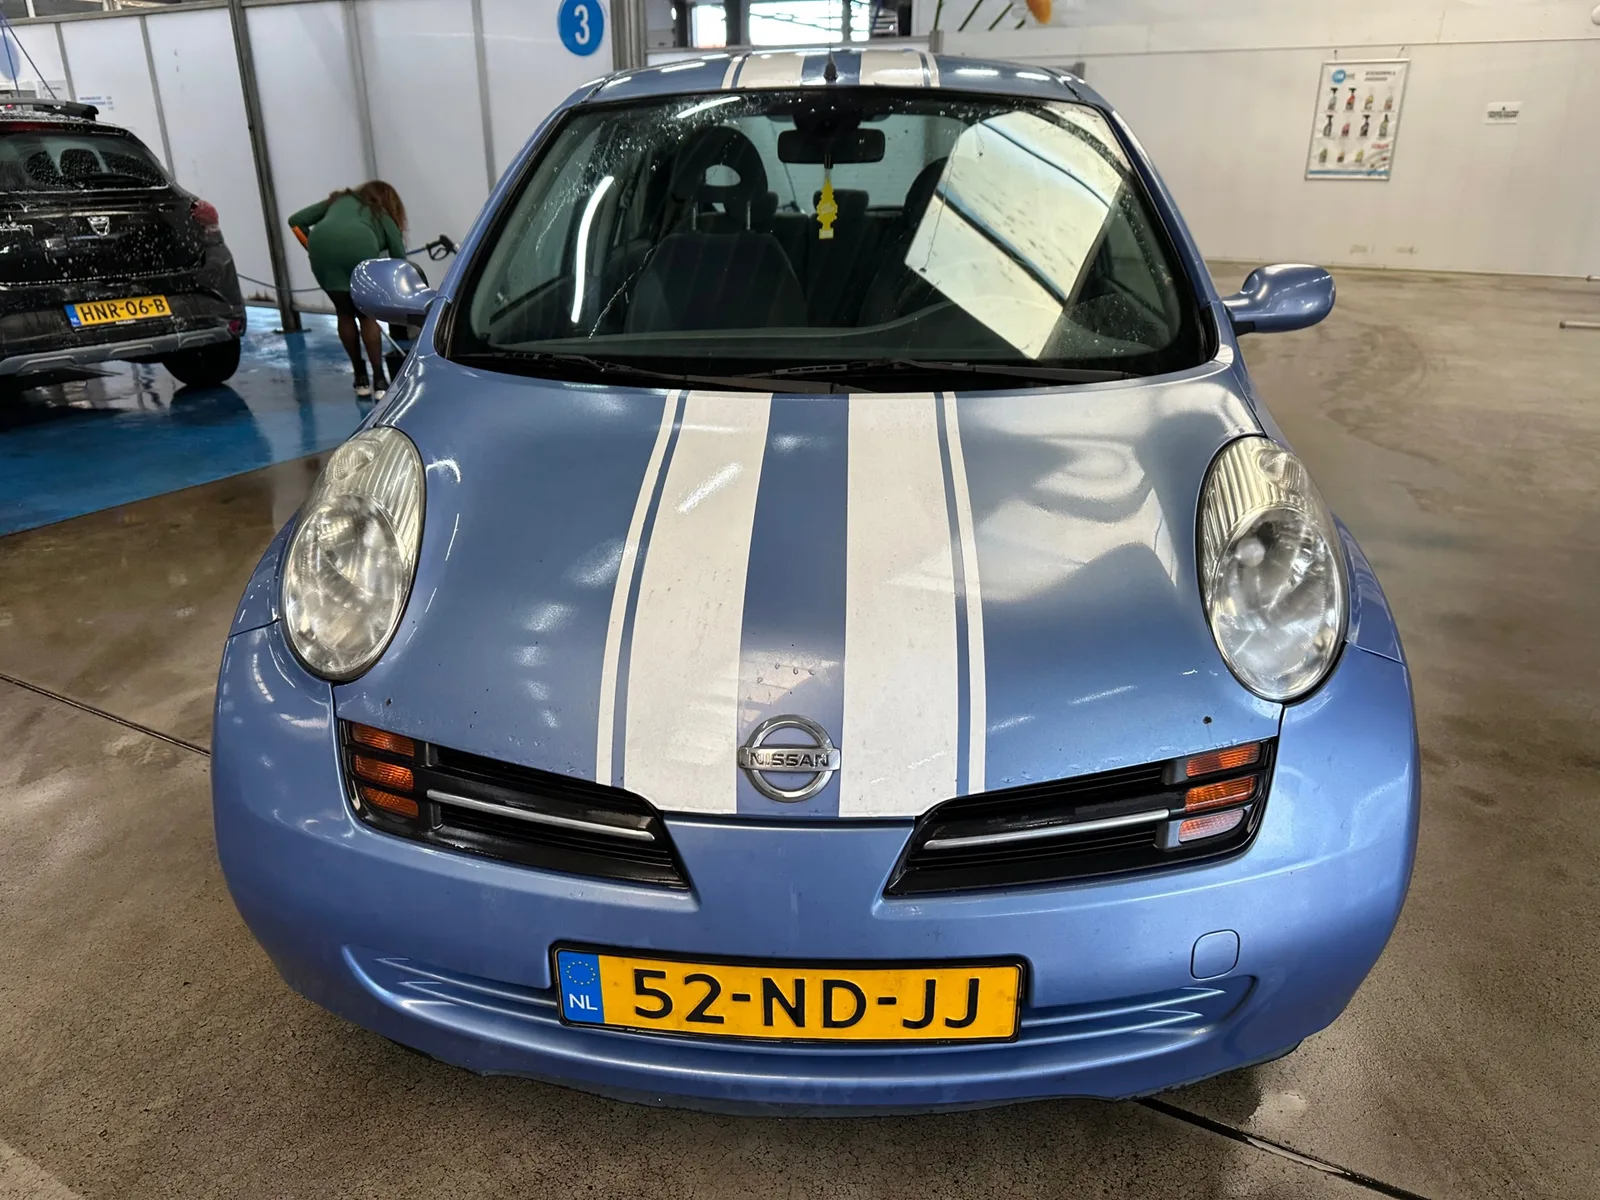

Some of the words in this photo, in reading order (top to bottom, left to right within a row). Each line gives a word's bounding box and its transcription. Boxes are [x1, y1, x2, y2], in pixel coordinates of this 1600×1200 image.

[574, 4, 590, 45] 3
[80, 298, 165, 322] HNR-06-B
[749, 752, 830, 767] NISSAN
[569, 994, 598, 1011] NL
[633, 968, 980, 1029] 52-ND-JJ
